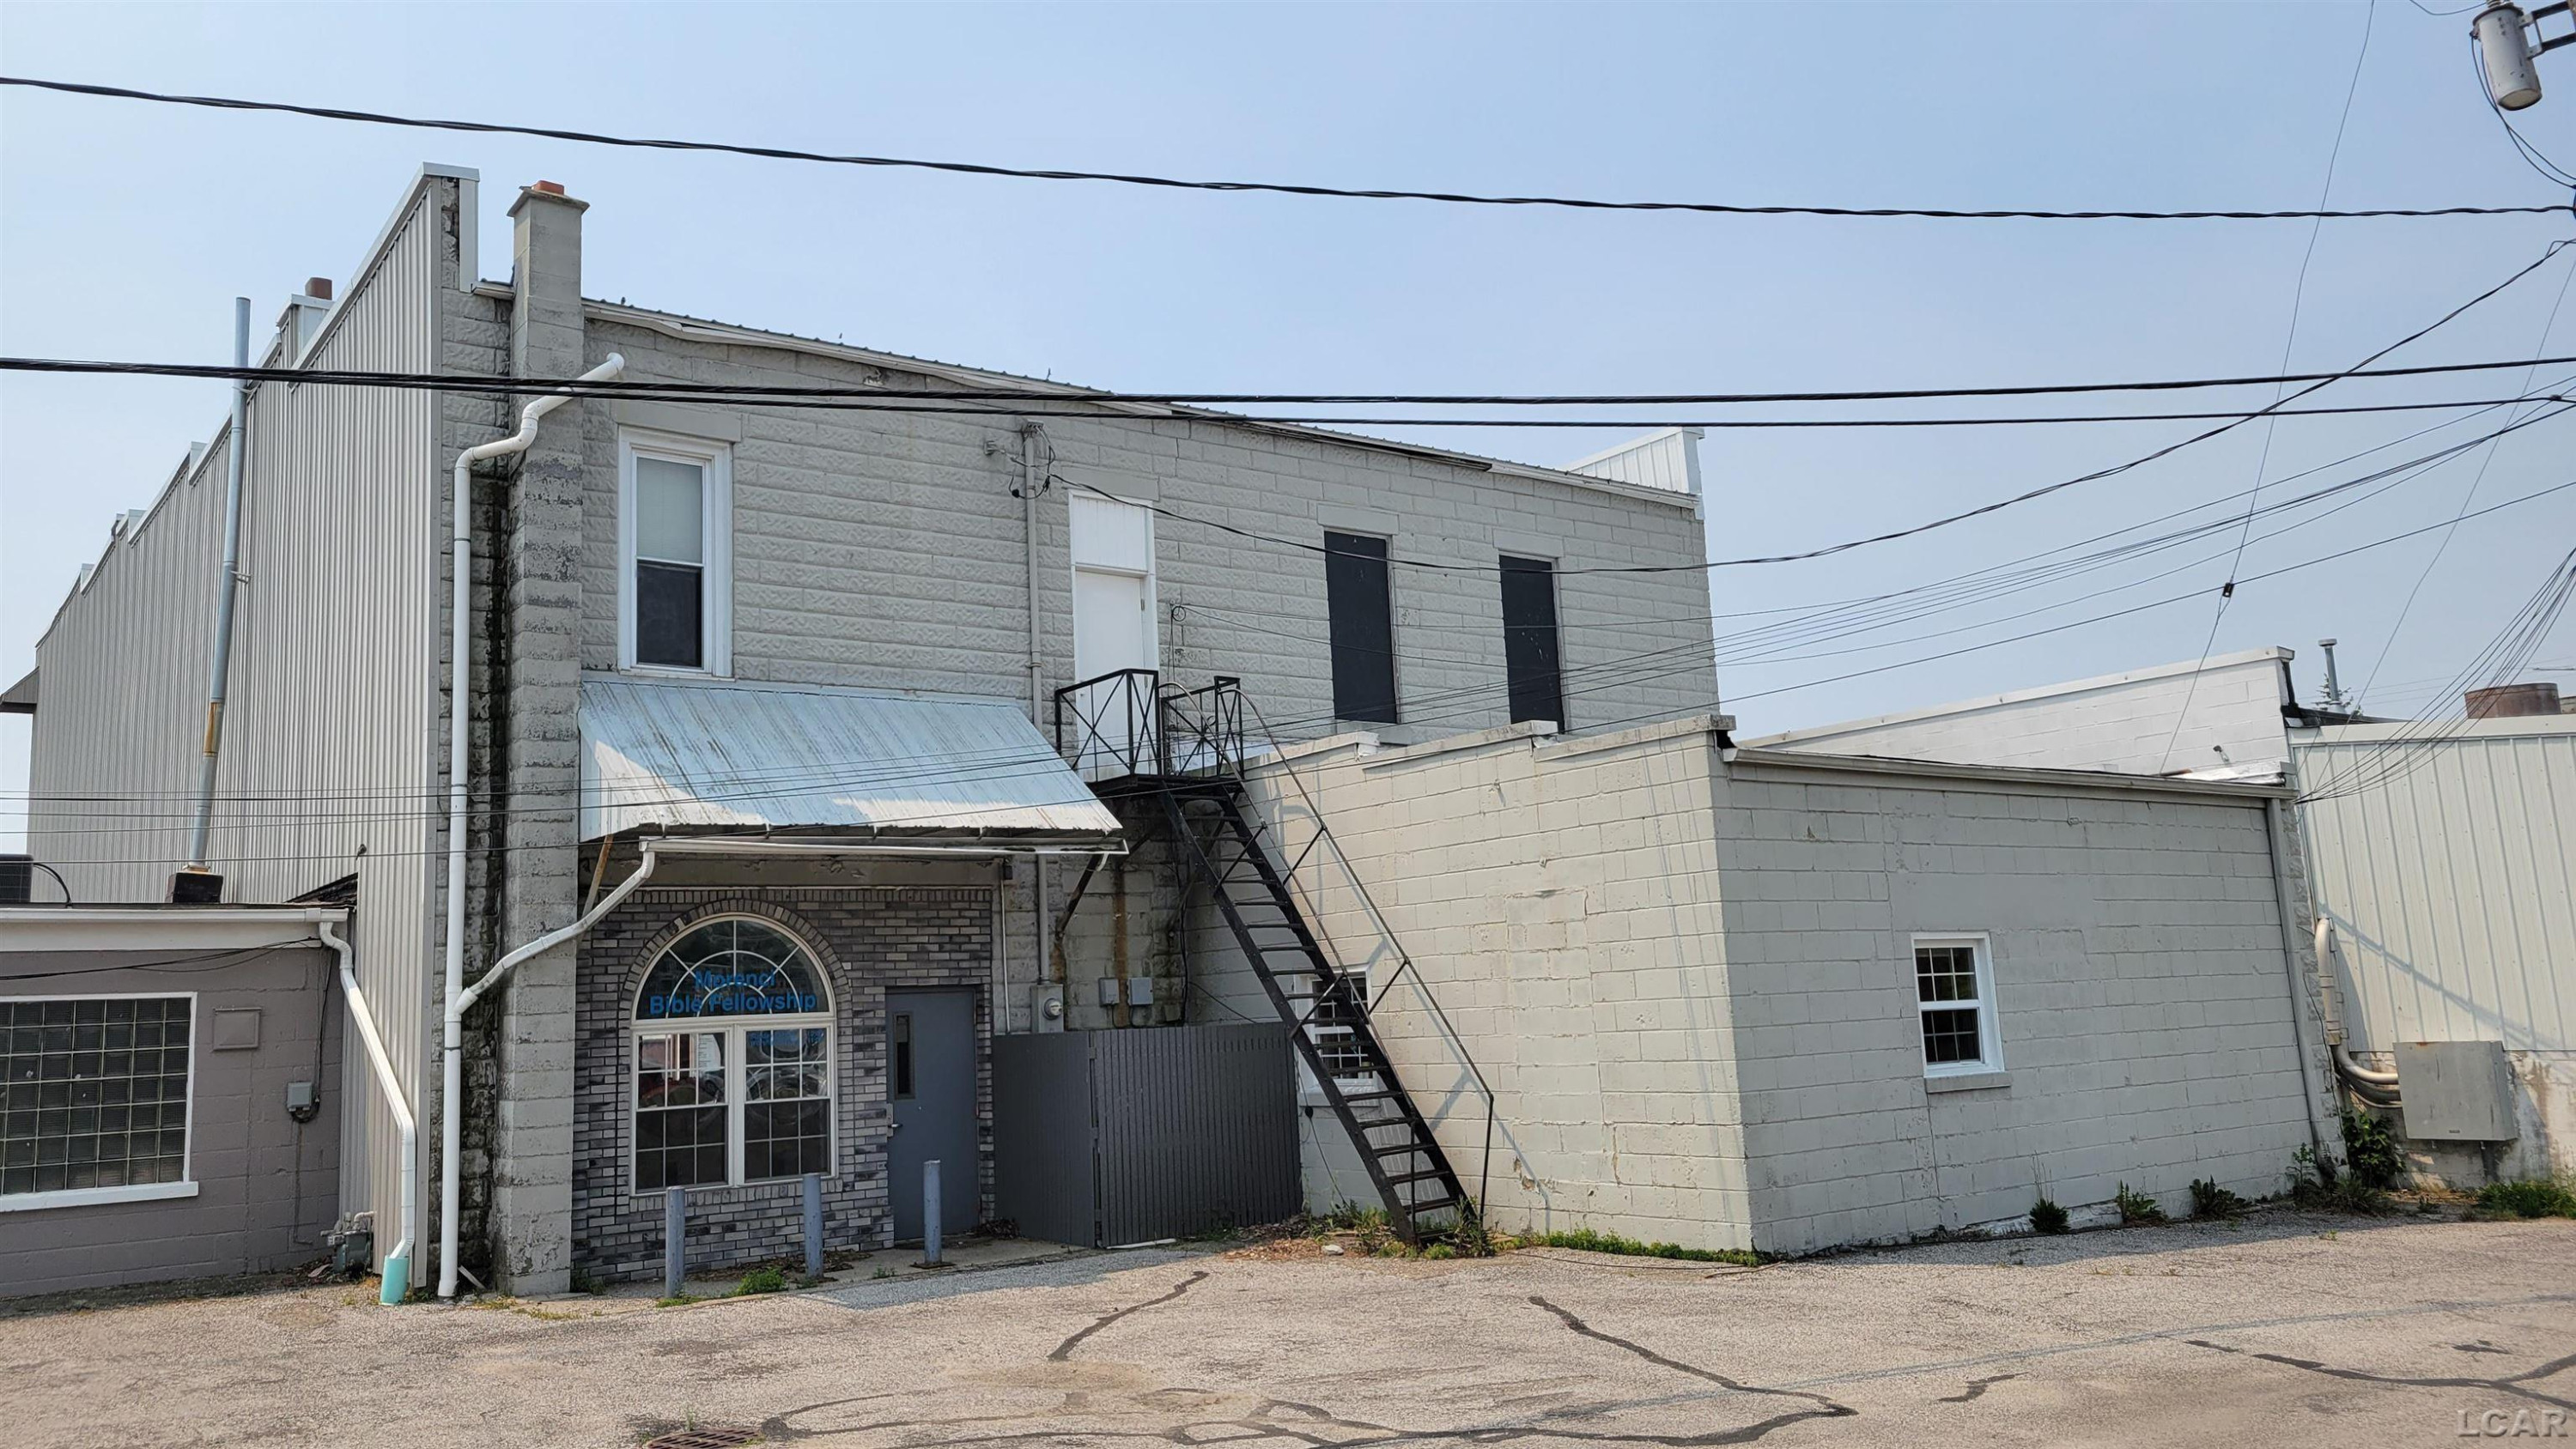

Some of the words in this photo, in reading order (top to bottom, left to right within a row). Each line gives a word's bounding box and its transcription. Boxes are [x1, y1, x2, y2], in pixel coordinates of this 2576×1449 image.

[695, 969, 776, 987] Morenci
[649, 994, 702, 1015] Bible
[709, 991, 817, 1013] Fellowship
